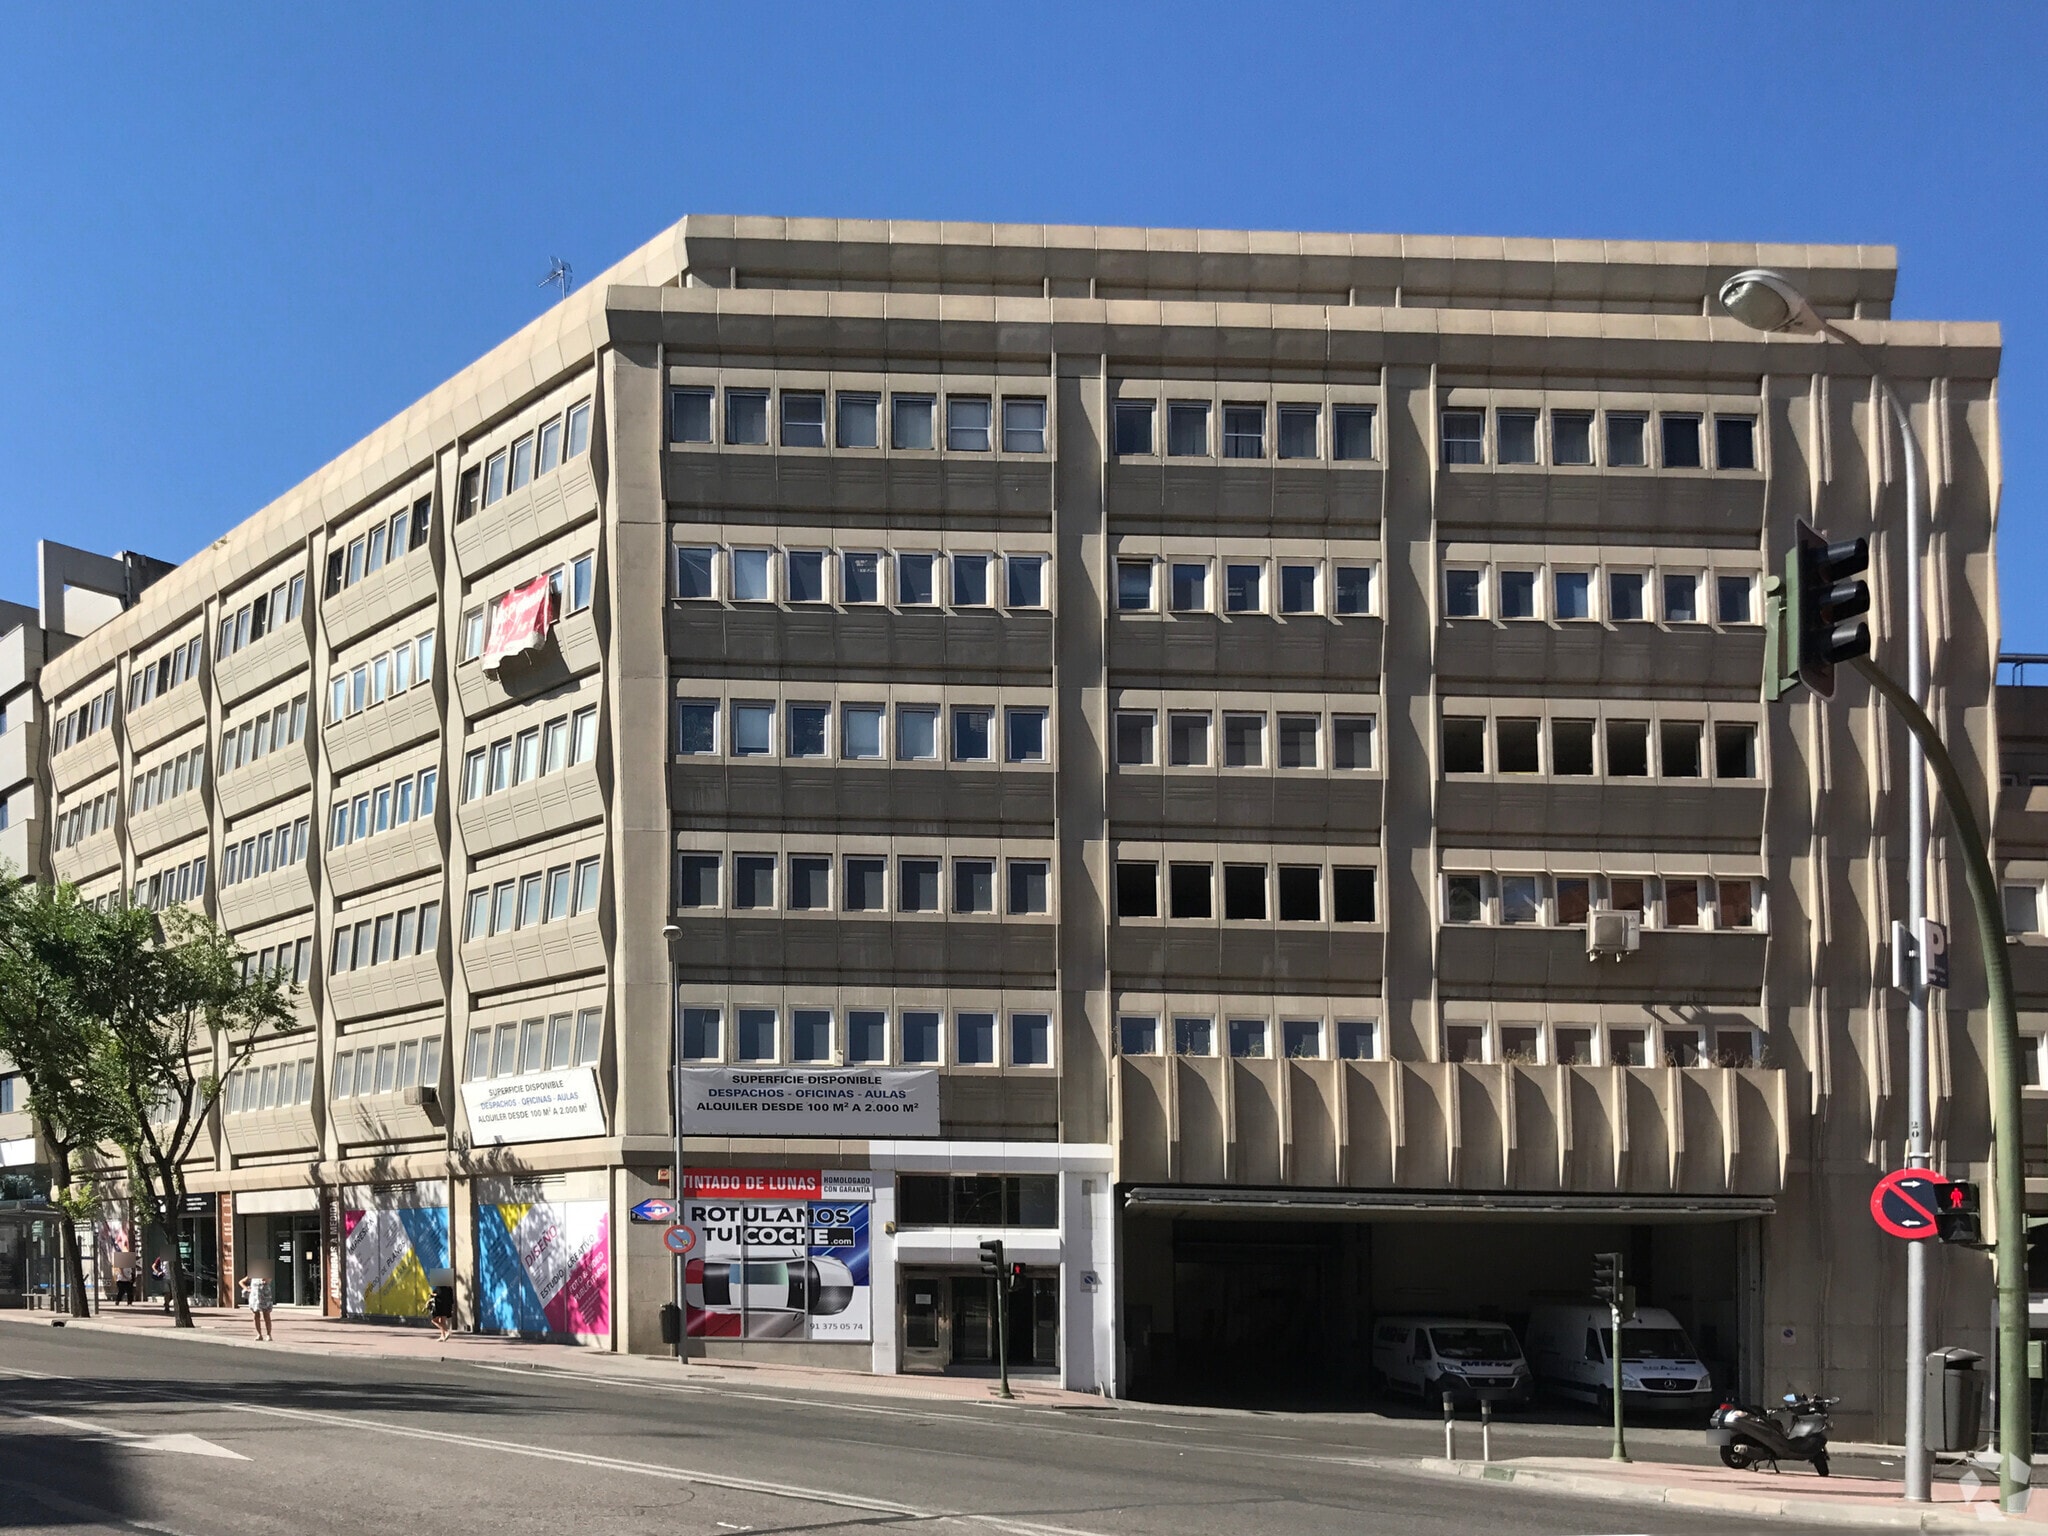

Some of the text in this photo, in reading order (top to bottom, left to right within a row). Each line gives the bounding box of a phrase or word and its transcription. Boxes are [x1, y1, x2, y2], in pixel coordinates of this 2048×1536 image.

[1925, 920, 1944, 970] P
[488, 1080, 564, 1097] SUPERFICIE DISPONIBLE
[732, 1075, 882, 1085] SUPERFICIE DISPONIBLE
[480, 1098, 517, 1110] DESPACHOS
[521, 1095, 552, 1106] OFICINAS
[557, 1092, 579, 1101] AULAS
[708, 1088, 784, 1098] DESPACHOS
[795, 1089, 854, 1099] OFICINAS
[864, 1090, 907, 1099] AULAS
[478, 1112, 507, 1124] ALQUILER
[508, 1108, 529, 1120] DESDE
[530, 1109, 542, 1118] 100
[553, 1106, 558, 1115] A
[560, 1105, 578, 1115] 2.000
[696, 1102, 758, 1112] ALQUILER
[762, 1103, 804, 1112] DESDE
[808, 1103, 829, 1112] 100
[852, 1103, 862, 1112] A
[865, 1104, 899, 1112] 2.000
[683, 1175, 816, 1191] TINTADO DE LUNAS
[823, 1176, 871, 1185] HOMOLOGADO
[823, 1185, 838, 1193] CON
[330, 1200, 338, 1235] MEDIDA
[692, 1206, 850, 1224] ROTULAMOS
[525, 1225, 558, 1267] DISEÑO
[540, 1269, 565, 1299] ESTUDIO
[567, 1234, 595, 1269] CREATIVO
